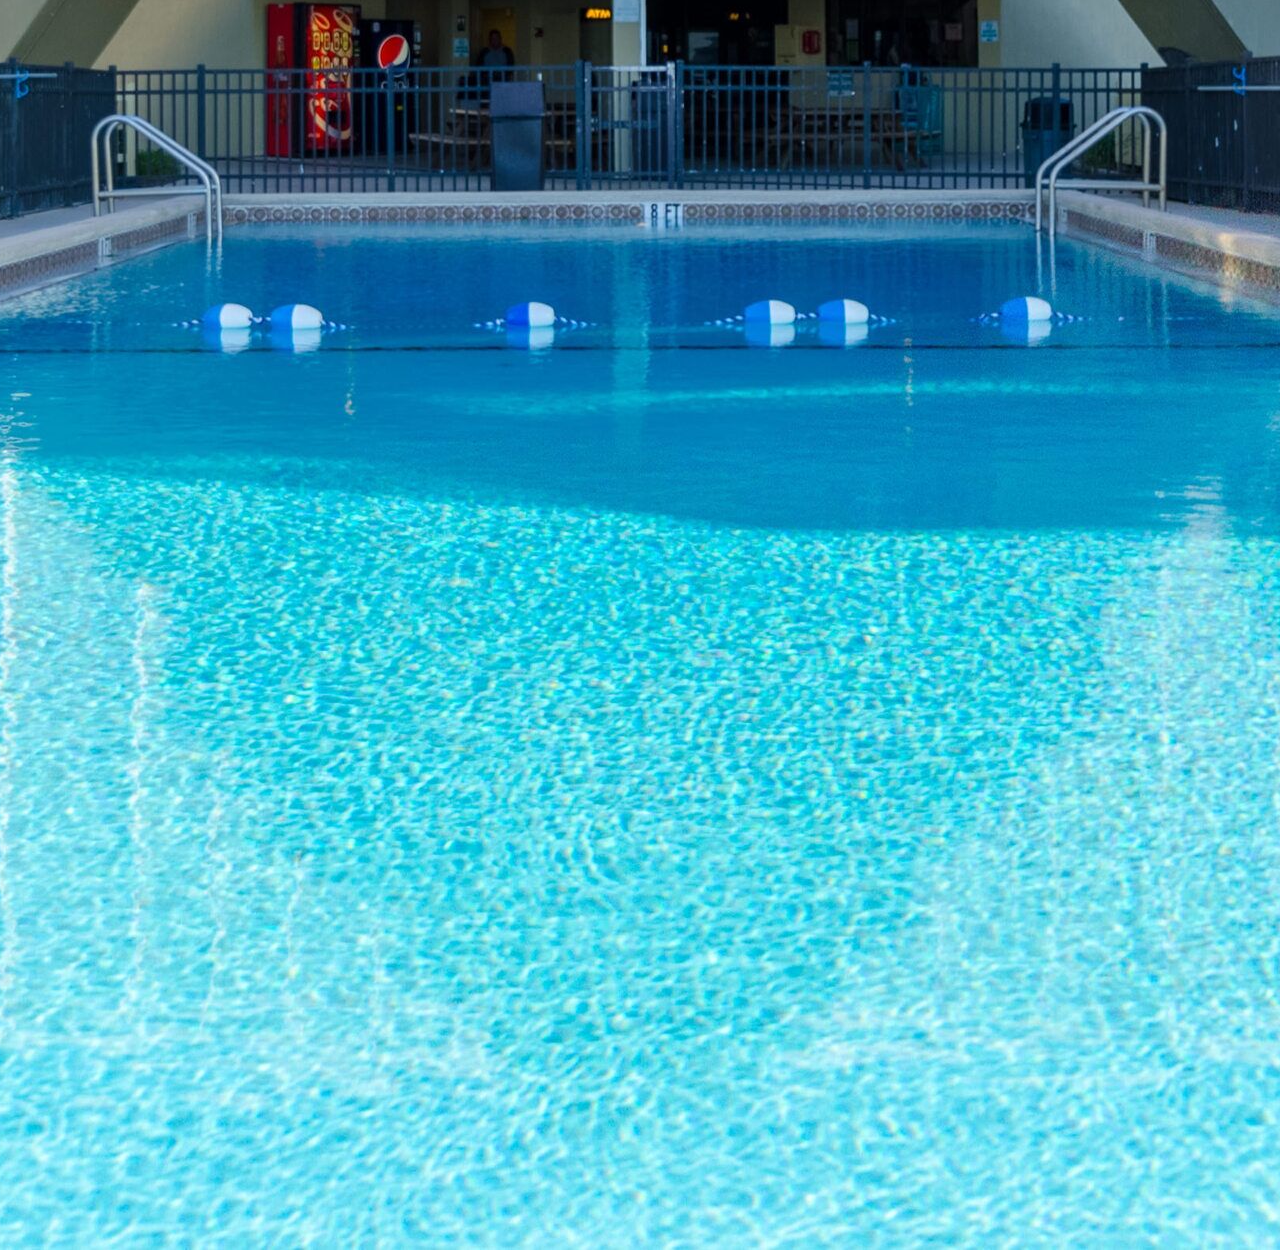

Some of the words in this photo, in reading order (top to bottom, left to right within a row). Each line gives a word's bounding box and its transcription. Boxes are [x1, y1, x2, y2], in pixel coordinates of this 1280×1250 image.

[586, 8, 611, 19] ATM
[651, 203, 658, 218] 8
[665, 203, 680, 219] FT
